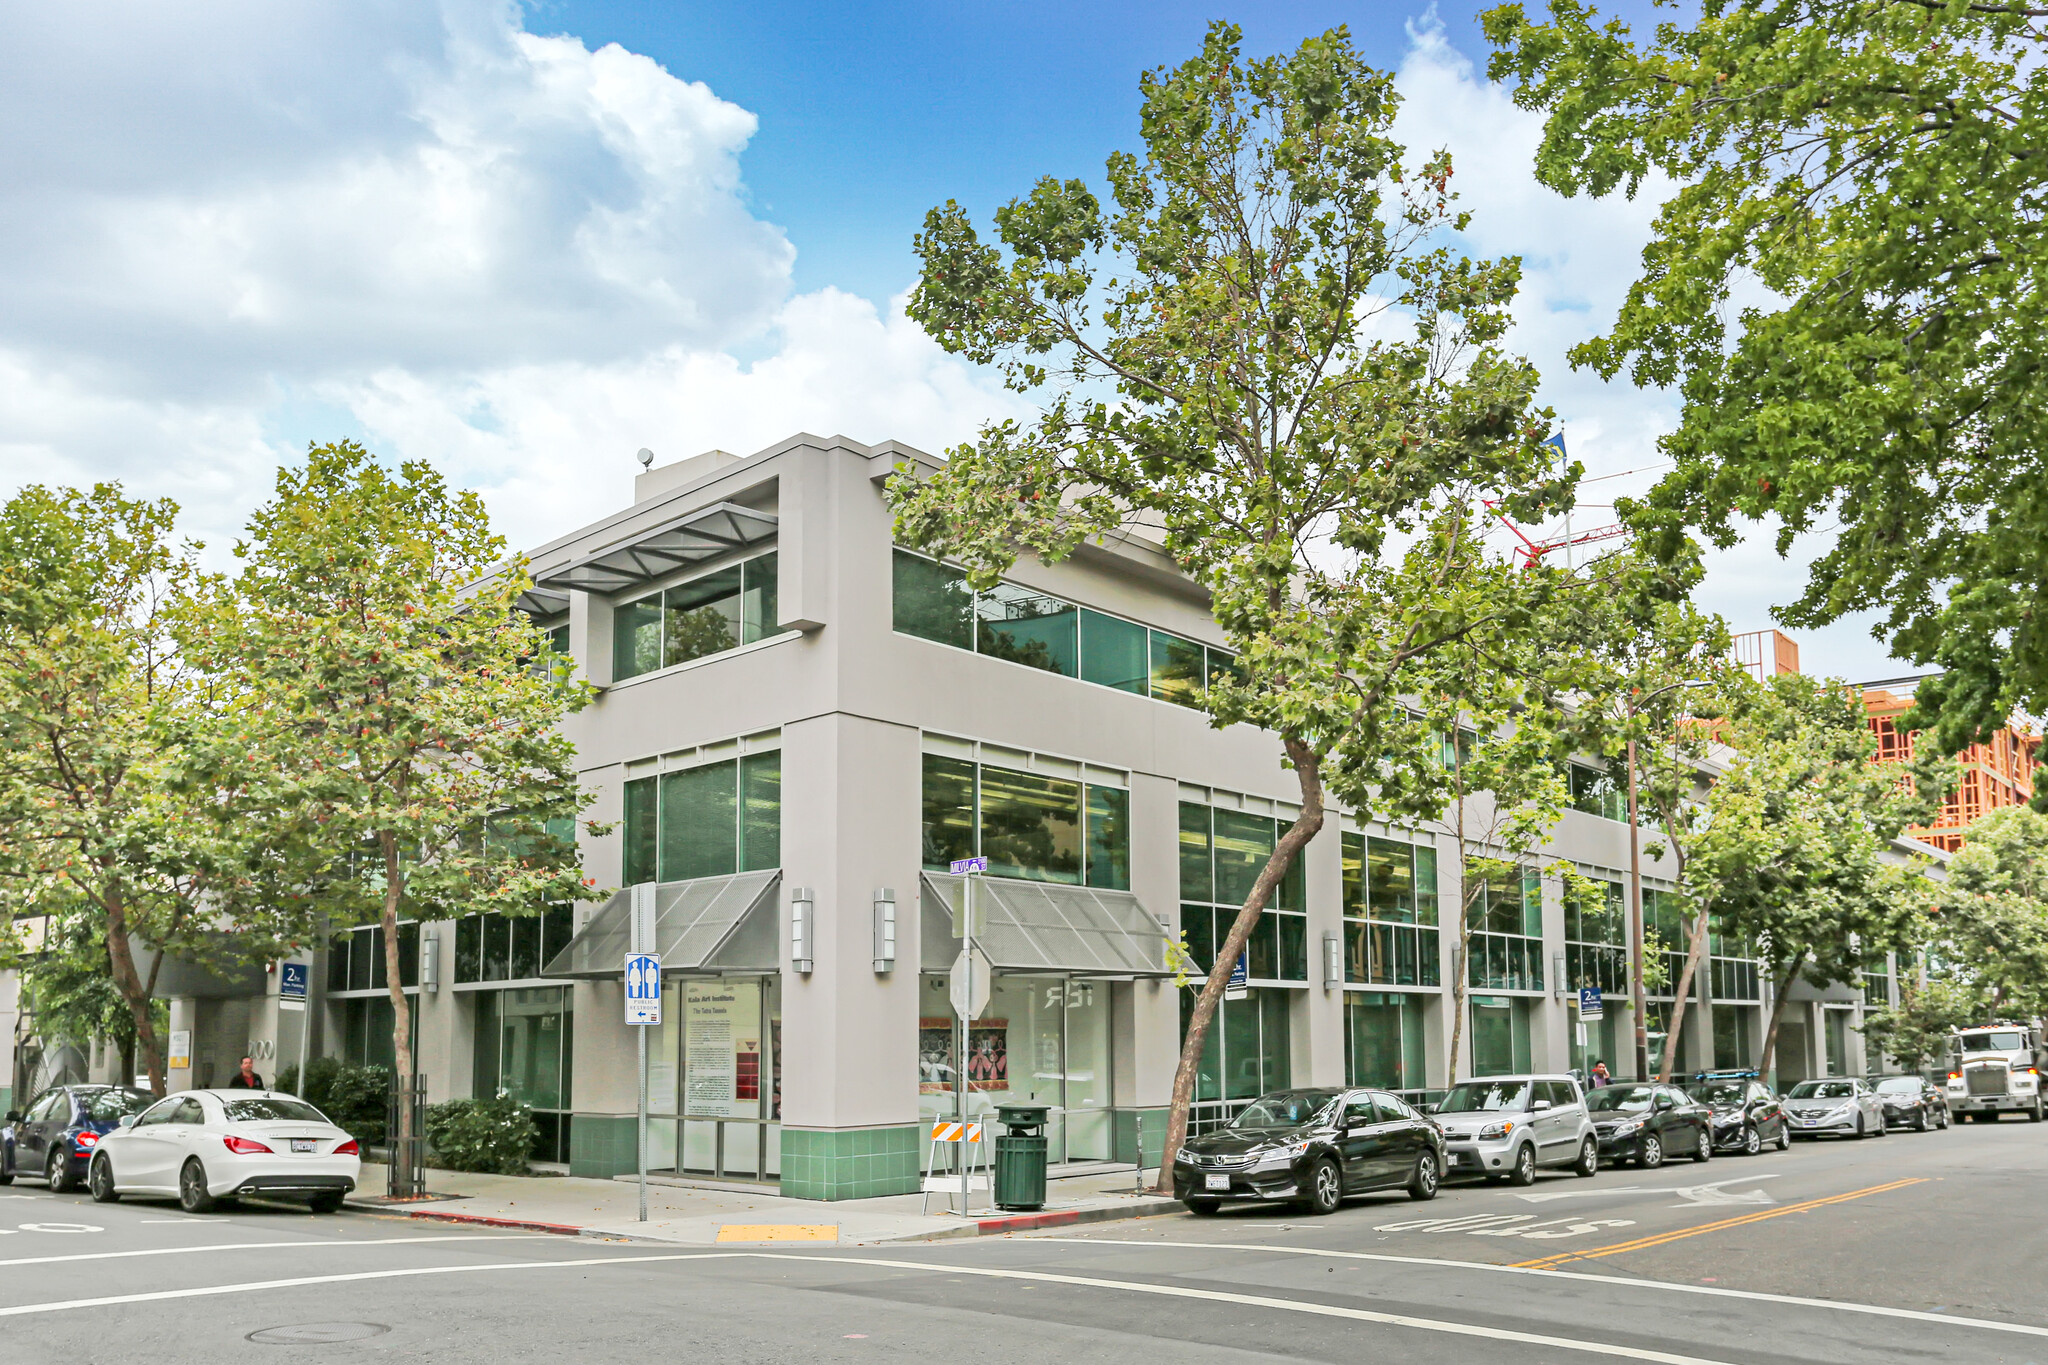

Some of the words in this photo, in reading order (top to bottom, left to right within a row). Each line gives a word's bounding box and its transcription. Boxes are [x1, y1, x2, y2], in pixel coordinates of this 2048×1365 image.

[951, 860, 969, 873] MILVIA
[287, 968, 295, 981] 2
[1584, 990, 1591, 1001] 2
